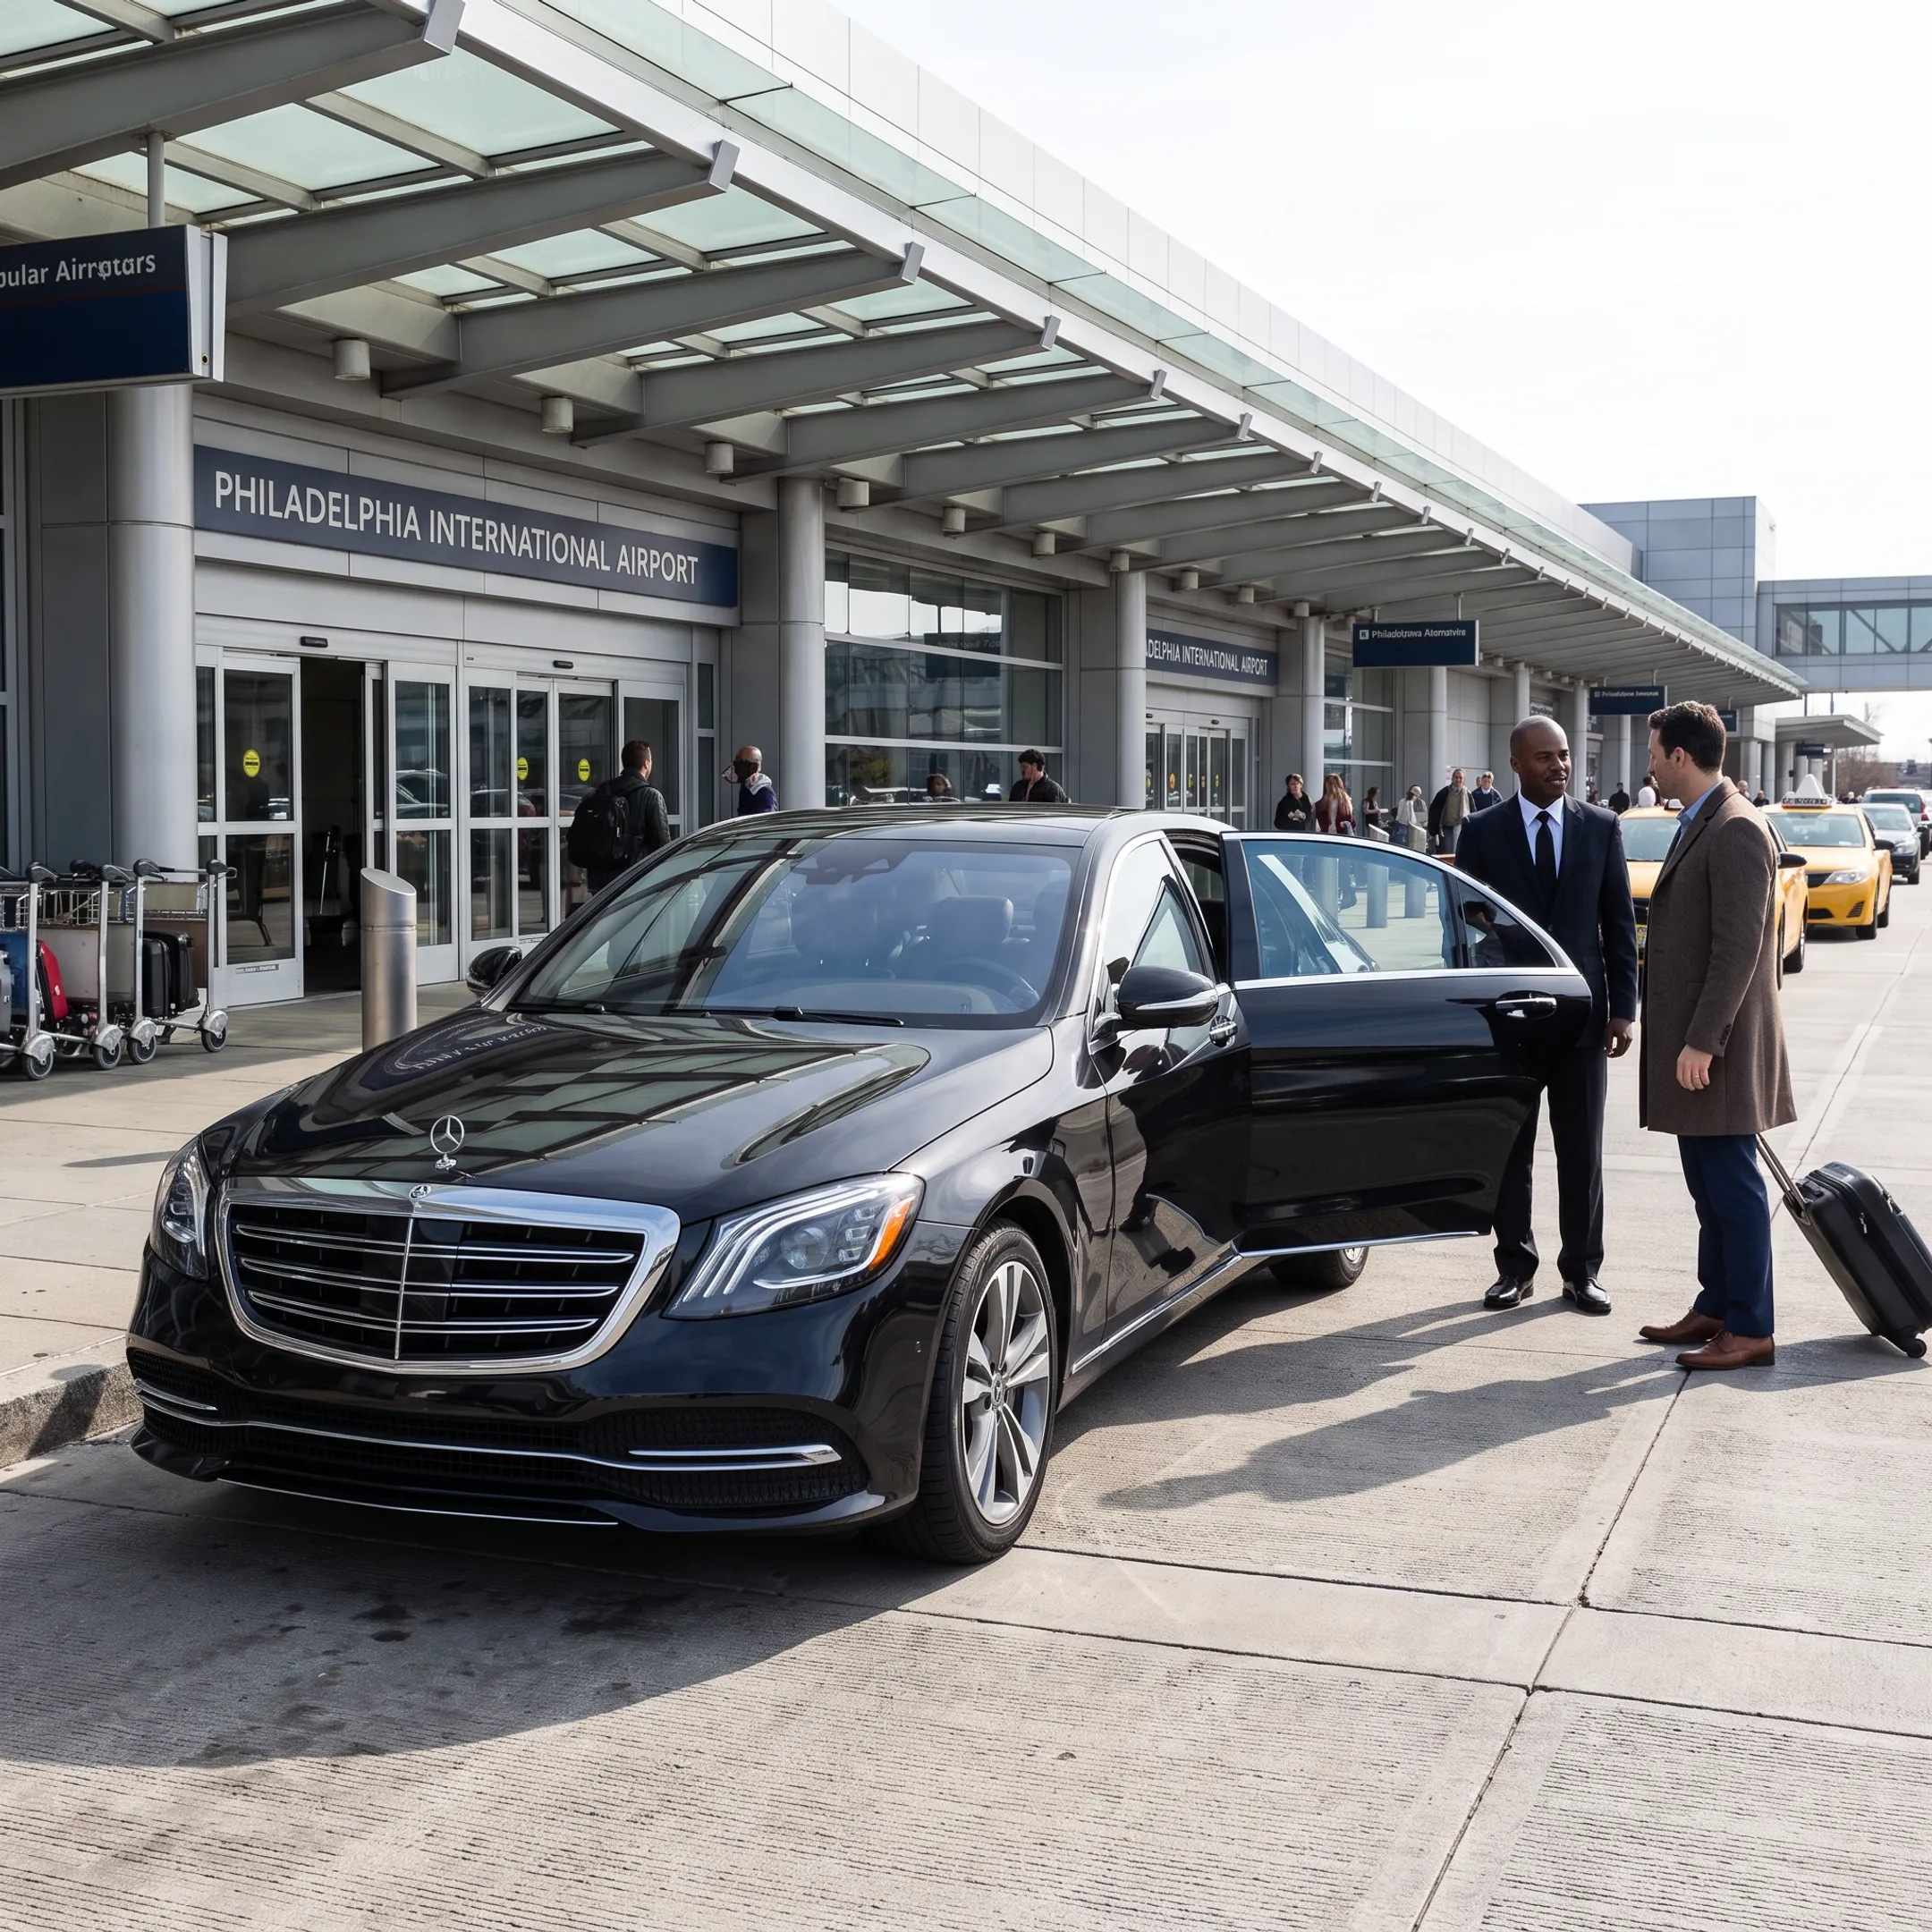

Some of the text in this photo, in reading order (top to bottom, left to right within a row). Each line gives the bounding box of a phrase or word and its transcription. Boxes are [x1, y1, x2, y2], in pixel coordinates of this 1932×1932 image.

[216, 471, 699, 584] PHILADELPHIA INTERNATIONAL AIRPORT
[1182, 645, 1240, 672] INTERNATIONAL
[1241, 656, 1267, 675] AIRPORT
